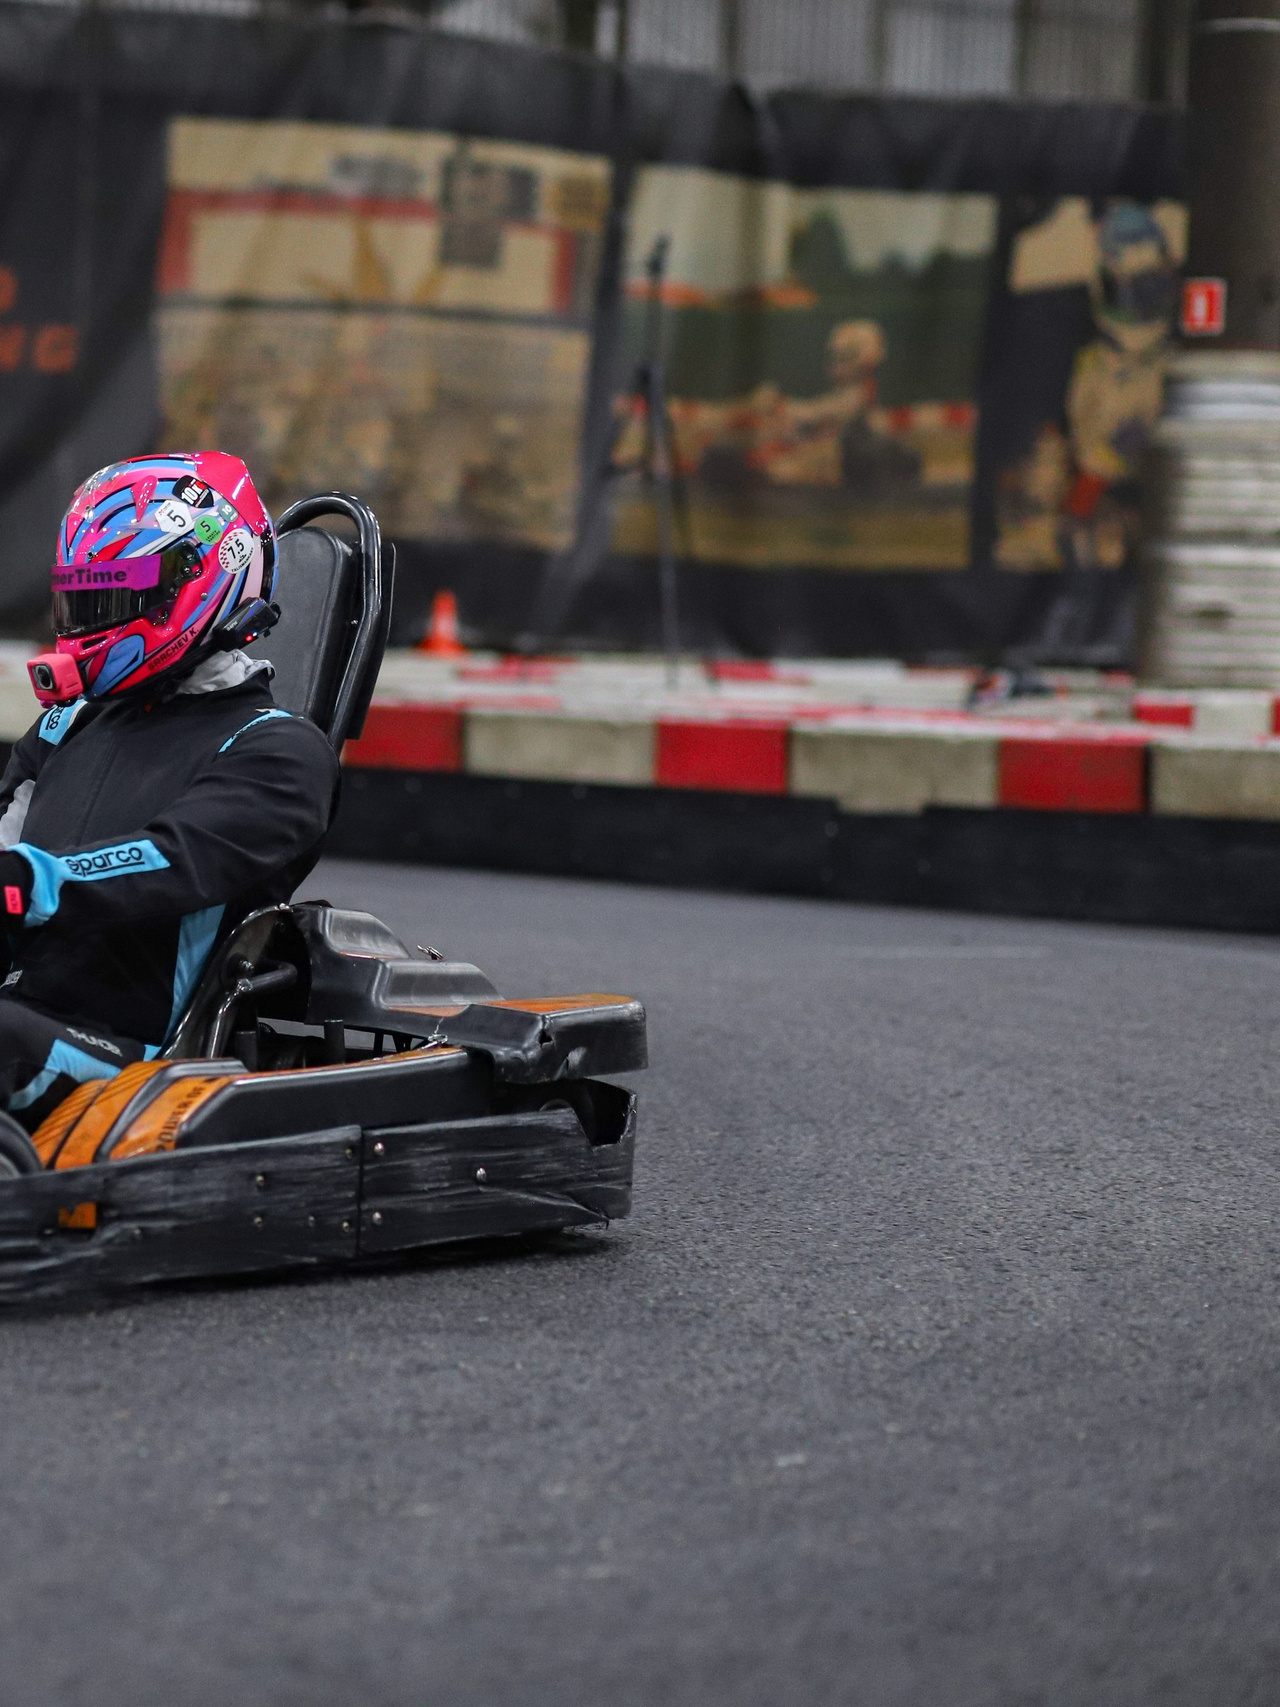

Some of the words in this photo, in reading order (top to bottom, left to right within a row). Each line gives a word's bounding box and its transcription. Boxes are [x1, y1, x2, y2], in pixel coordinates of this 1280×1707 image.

[166, 509, 187, 528] 5
[221, 504, 233, 515] 10
[200, 520, 211, 533] 5
[227, 538, 245, 559] 7.5
[65, 847, 144, 877] sparco
